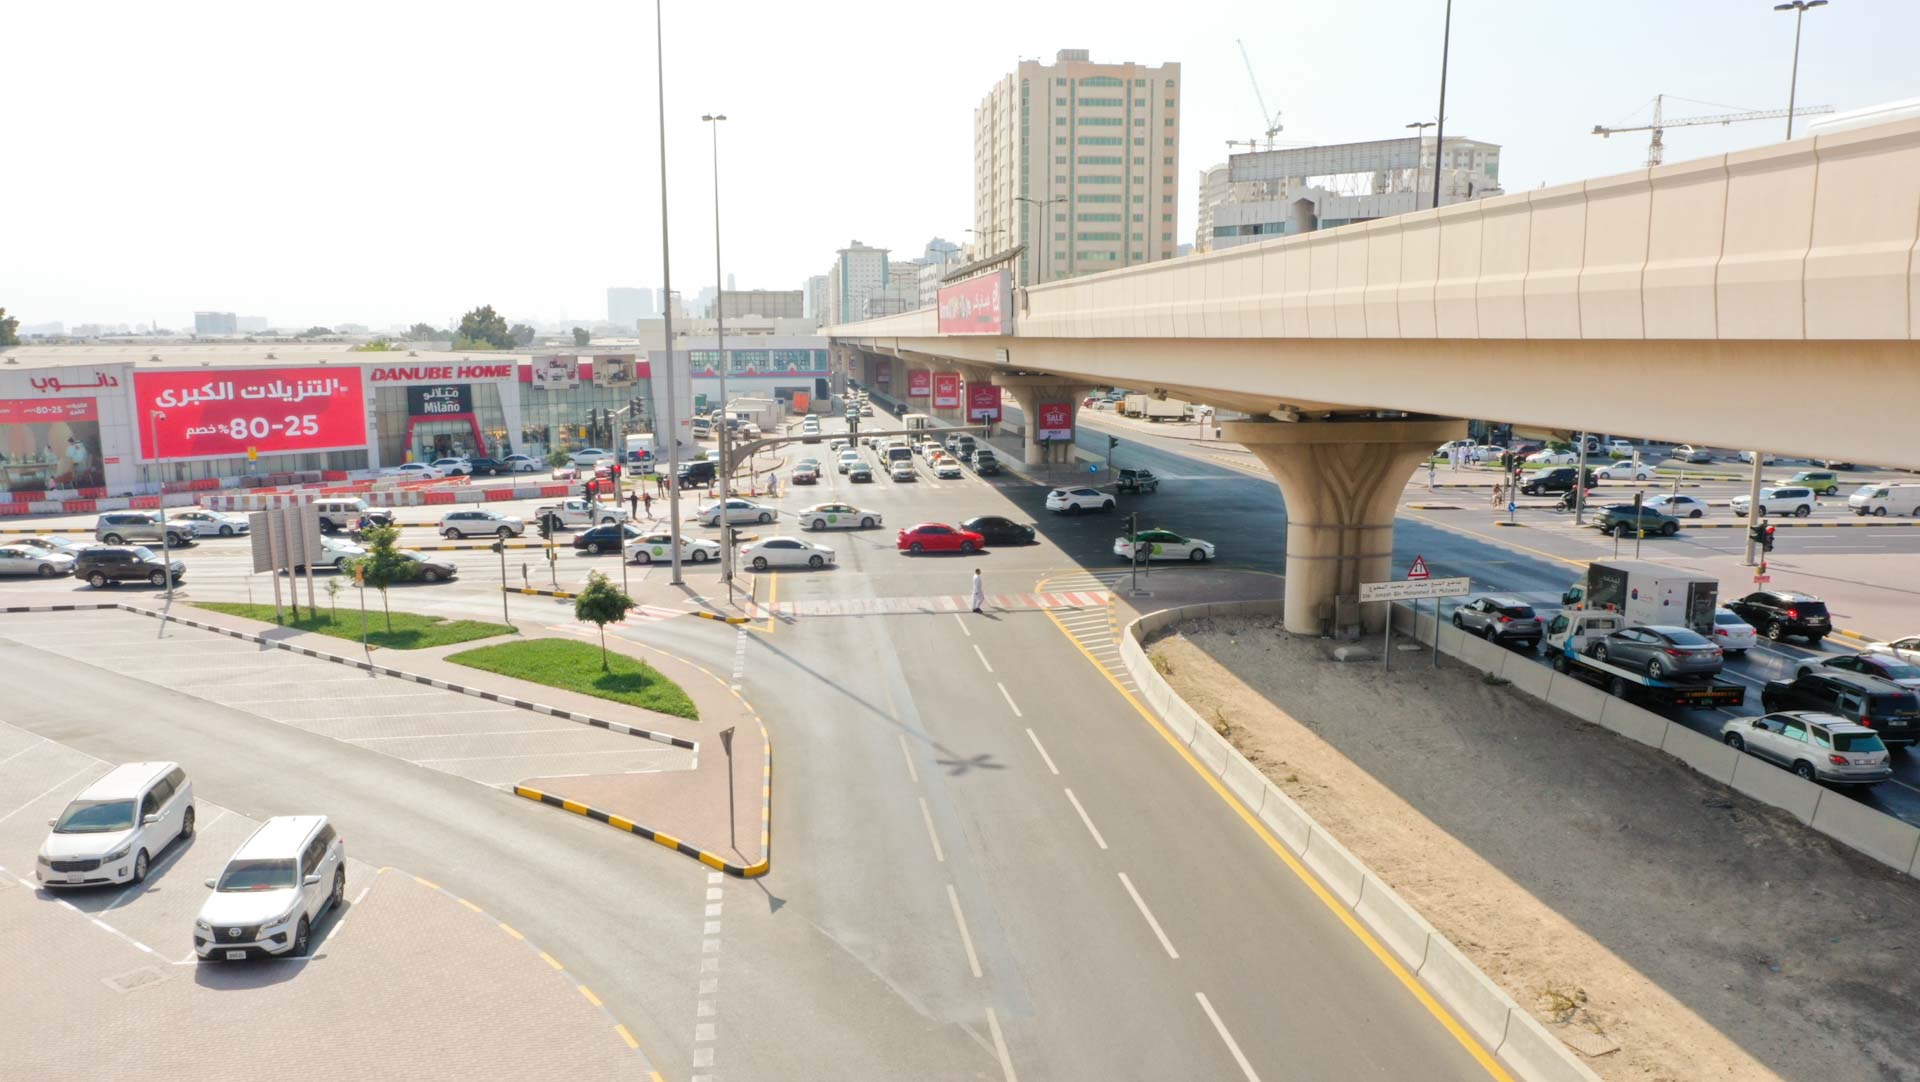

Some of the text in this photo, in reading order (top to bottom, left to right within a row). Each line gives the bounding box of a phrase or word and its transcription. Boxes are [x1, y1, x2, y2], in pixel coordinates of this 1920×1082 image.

[371, 365, 512, 381] DANUBE HOME
[30, 372, 119, 392] دانوب
[155, 382, 234, 407] الكبرى
[423, 387, 459, 400] ميلانو
[424, 401, 460, 413] Milano
[1046, 413, 1065, 421] SALE
[186, 423, 217, 438] خصم
